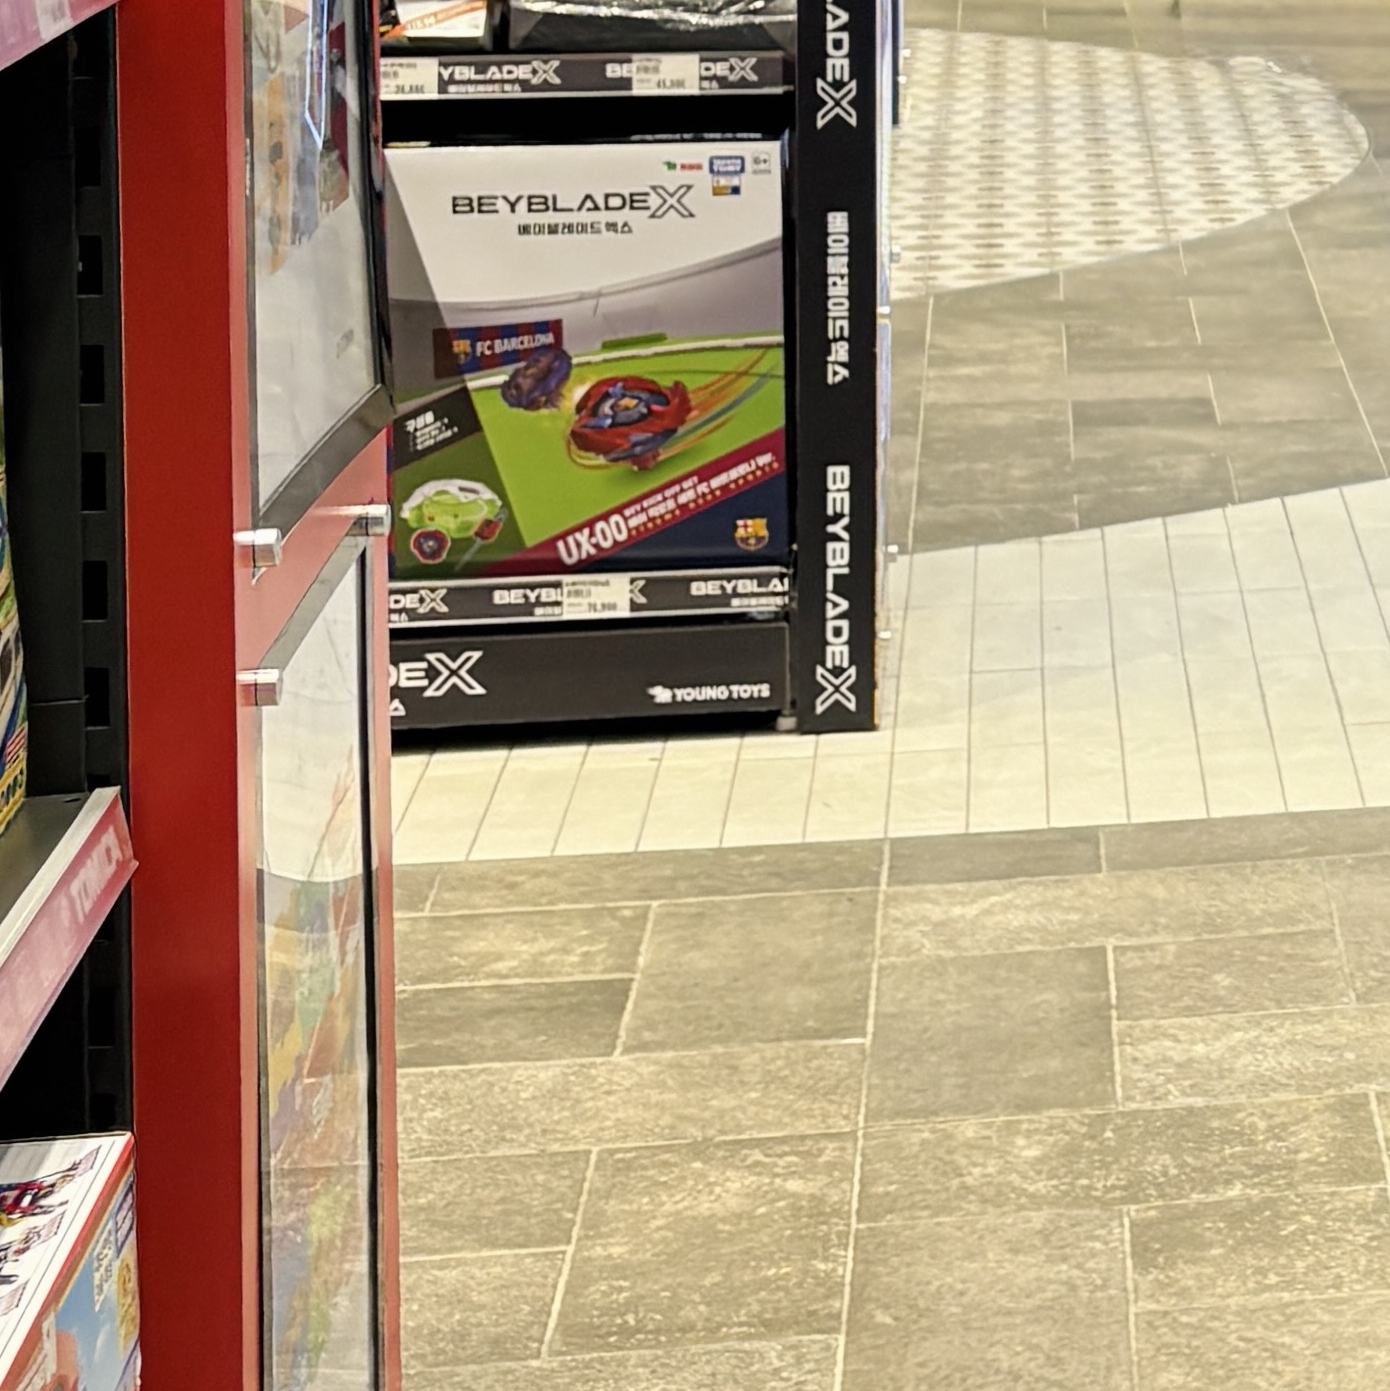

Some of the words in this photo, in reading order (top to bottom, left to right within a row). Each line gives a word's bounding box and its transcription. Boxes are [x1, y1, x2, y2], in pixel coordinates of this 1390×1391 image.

[451, 184, 696, 219] BEYBLADEX
[476, 338, 493, 357] FC
[557, 515, 629, 567] UX-00
[816, 464, 857, 715] BEYBLADEX
[672, 686, 729, 703] YOUNG
[728, 683, 771, 700] TOYS
